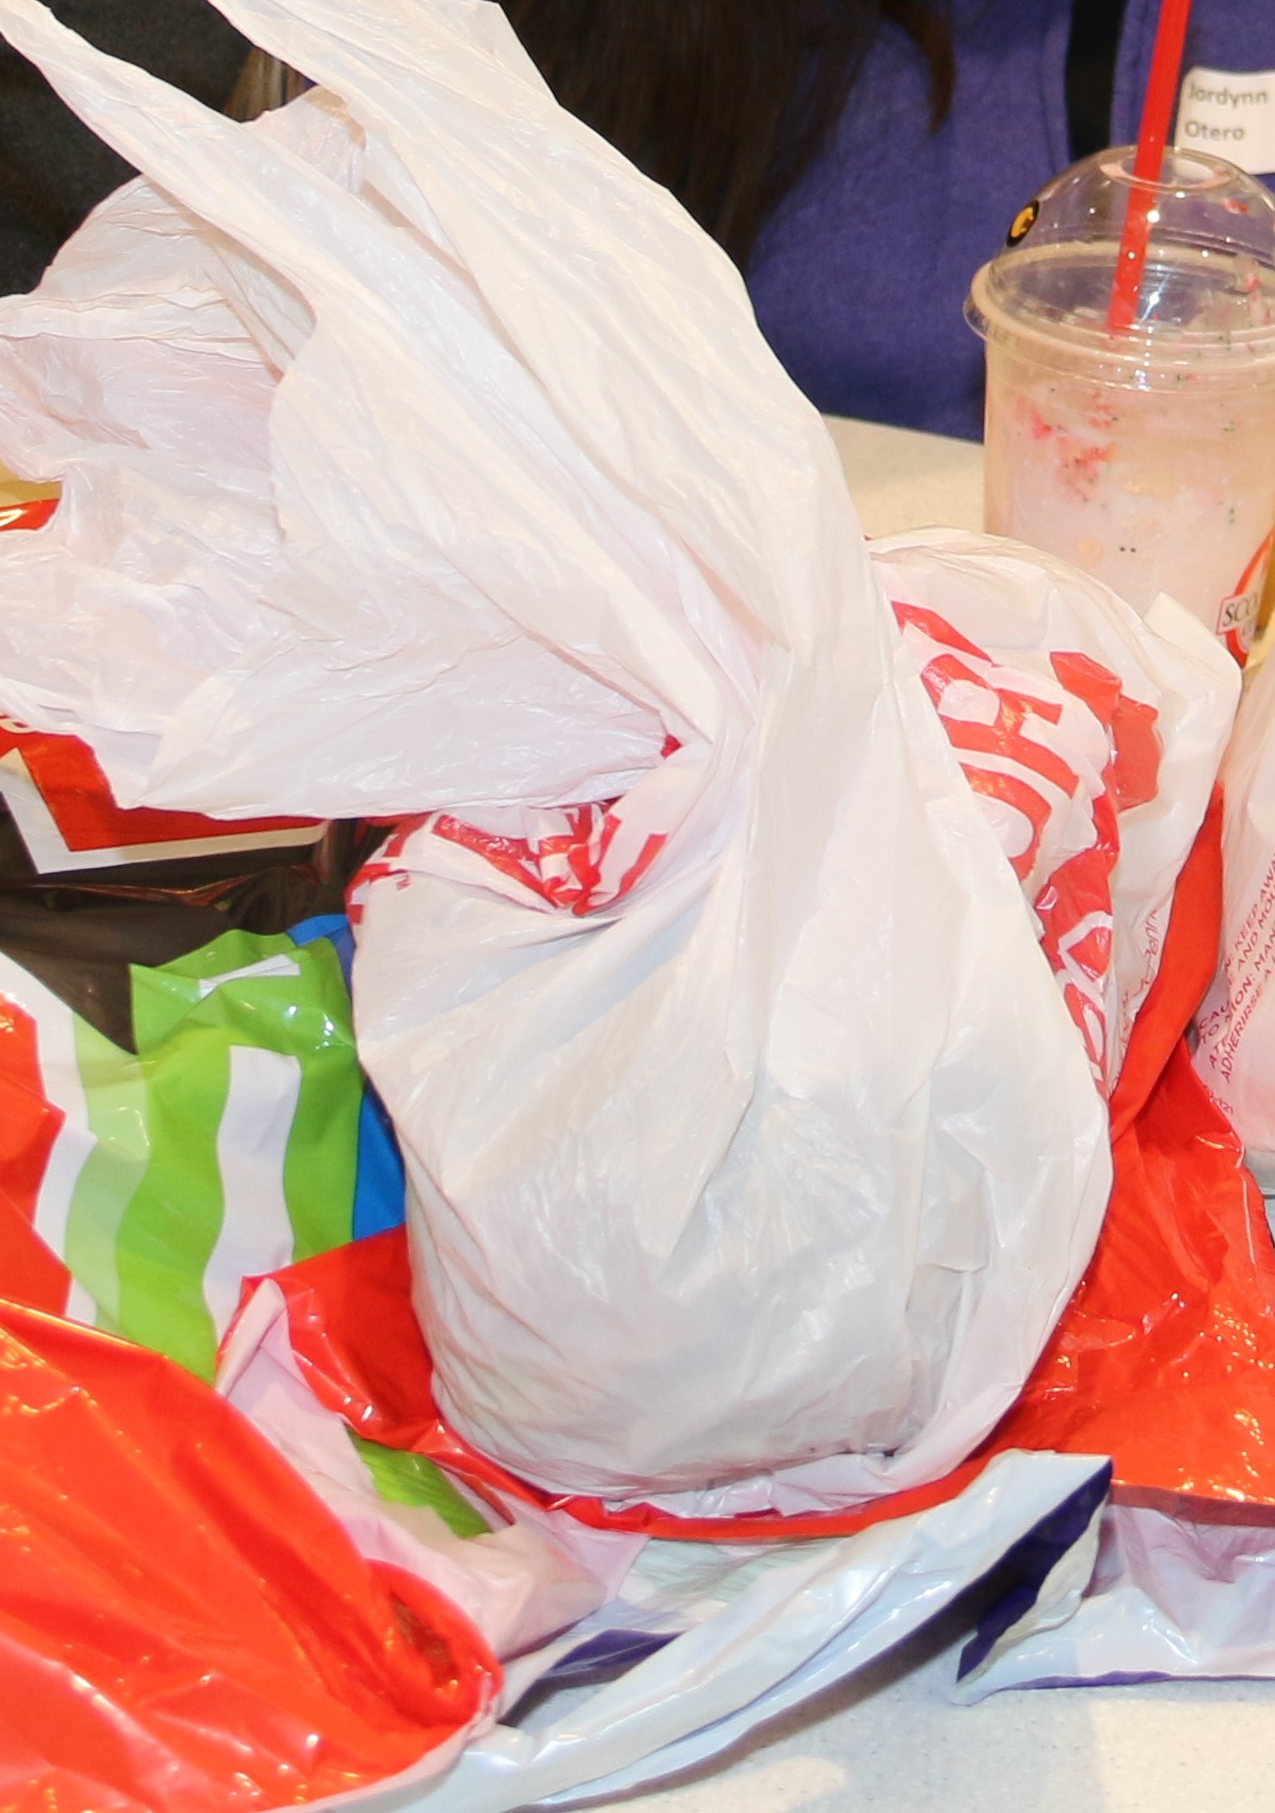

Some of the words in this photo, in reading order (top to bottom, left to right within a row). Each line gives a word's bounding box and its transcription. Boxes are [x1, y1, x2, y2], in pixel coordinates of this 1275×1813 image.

[1184, 120, 1245, 141] Otero
[1233, 903, 1258, 951] KEEP
[1237, 931, 1259, 971] AND
[1220, 983, 1264, 1085] ADHERIRSE
